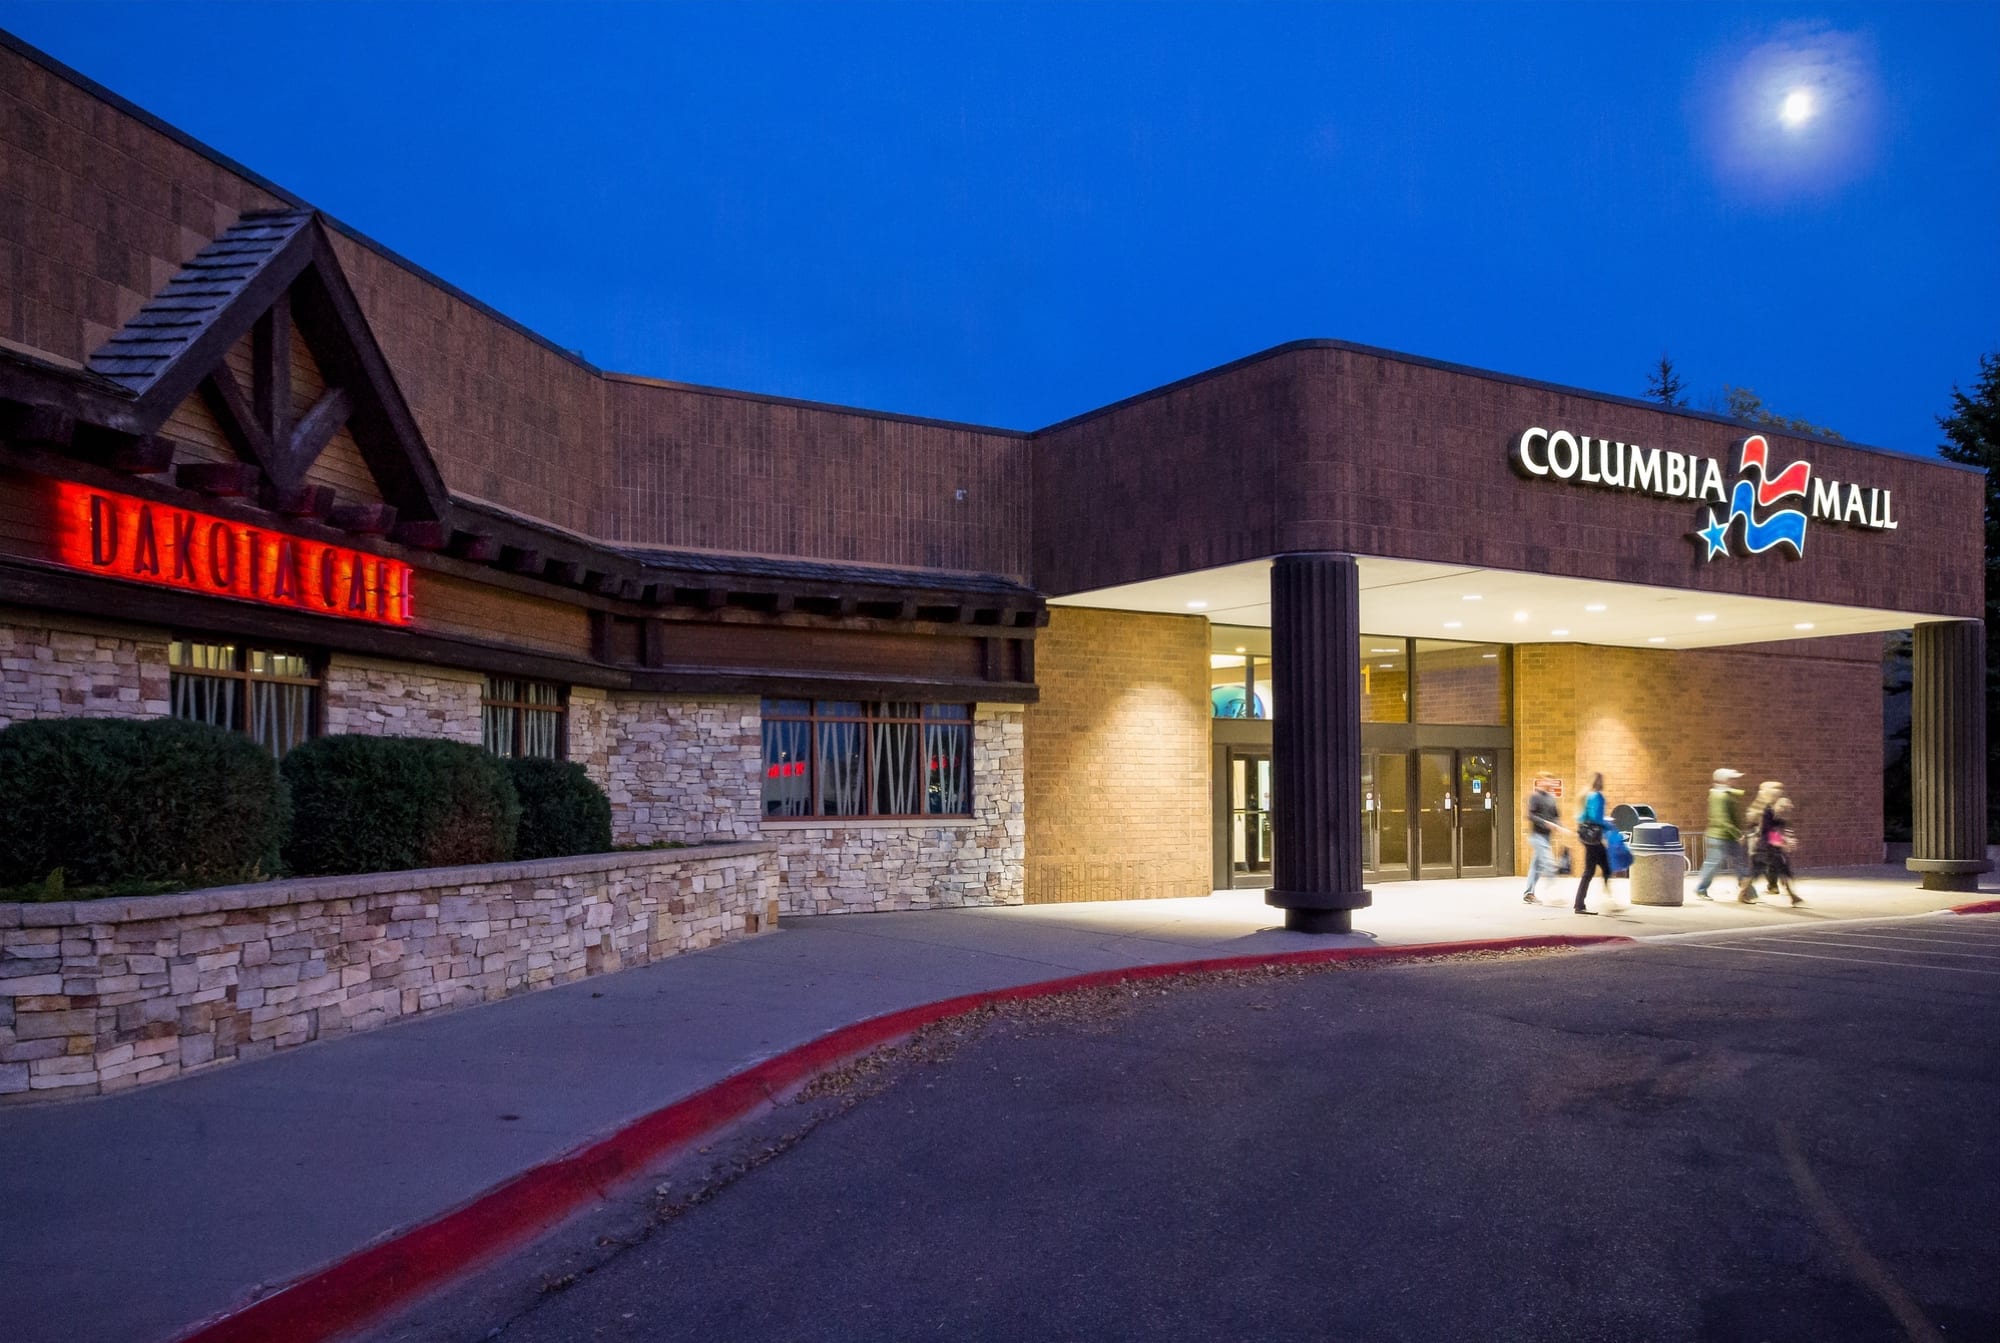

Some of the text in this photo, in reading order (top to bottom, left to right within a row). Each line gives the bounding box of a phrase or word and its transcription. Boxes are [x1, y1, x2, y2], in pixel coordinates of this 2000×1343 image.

[1519, 426, 1898, 530] COLUMBIA MALL
[89, 493, 415, 620] DAKOTA CAFE
